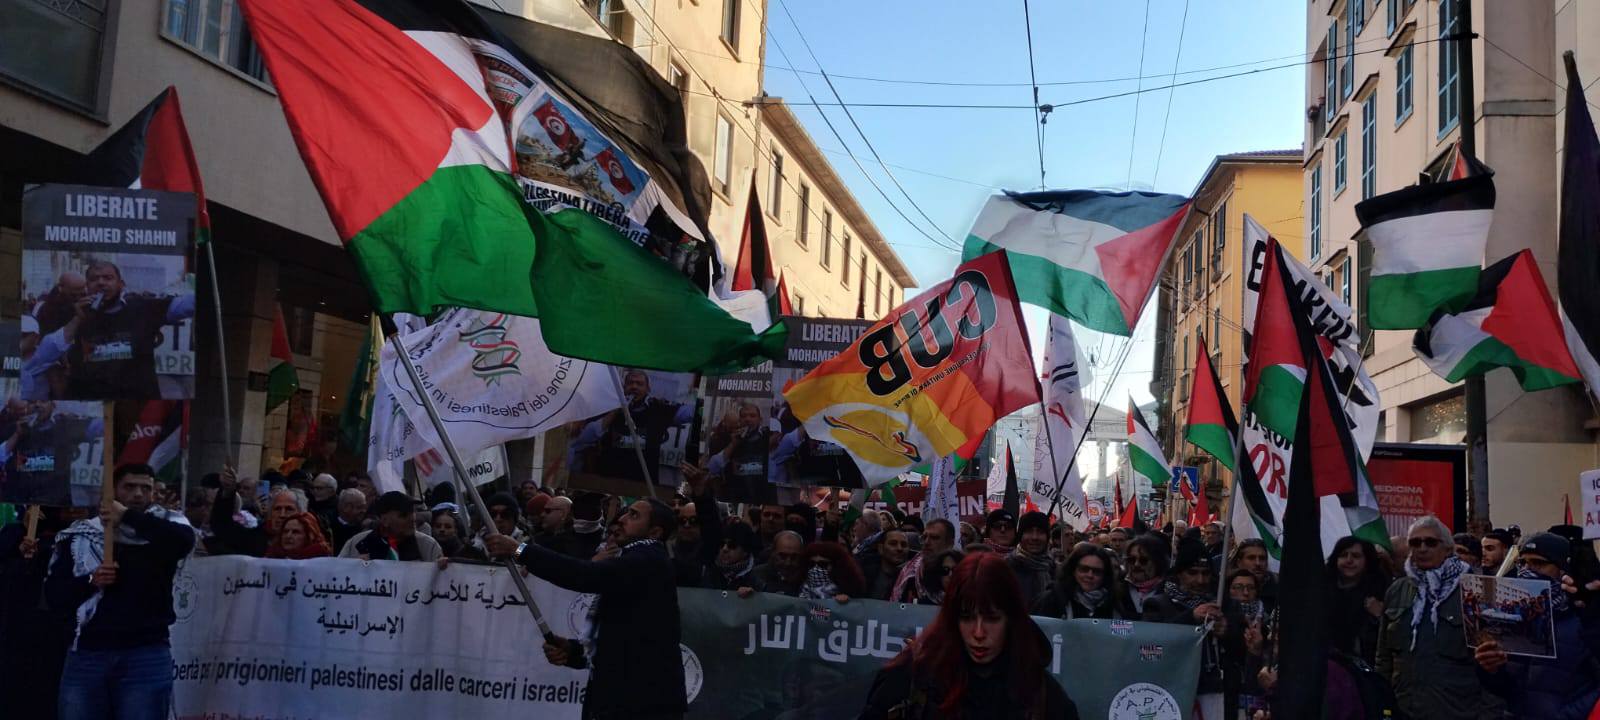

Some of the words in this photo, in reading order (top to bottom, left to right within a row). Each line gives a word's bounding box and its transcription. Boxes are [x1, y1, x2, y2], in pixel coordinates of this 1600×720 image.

[65, 193, 158, 221] LIBERATE
[45, 226, 121, 244] MOHAMED
[126, 229, 176, 246] SHAHIN
[718, 379, 763, 392] MOHAMED
[896, 494, 985, 517] SHIN
[1377, 494, 1424, 508] ZIONA
[275, 571, 297, 597] في
[302, 576, 398, 599] الفلسطينيين
[744, 613, 806, 655] النار
[817, 618, 923, 663] طلاق
[215, 656, 306, 686] prigionieri
[311, 663, 404, 691] palestinesi
[410, 668, 455, 692] dalle
[459, 676, 517, 700] carceri
[522, 677, 587, 705] israelia
